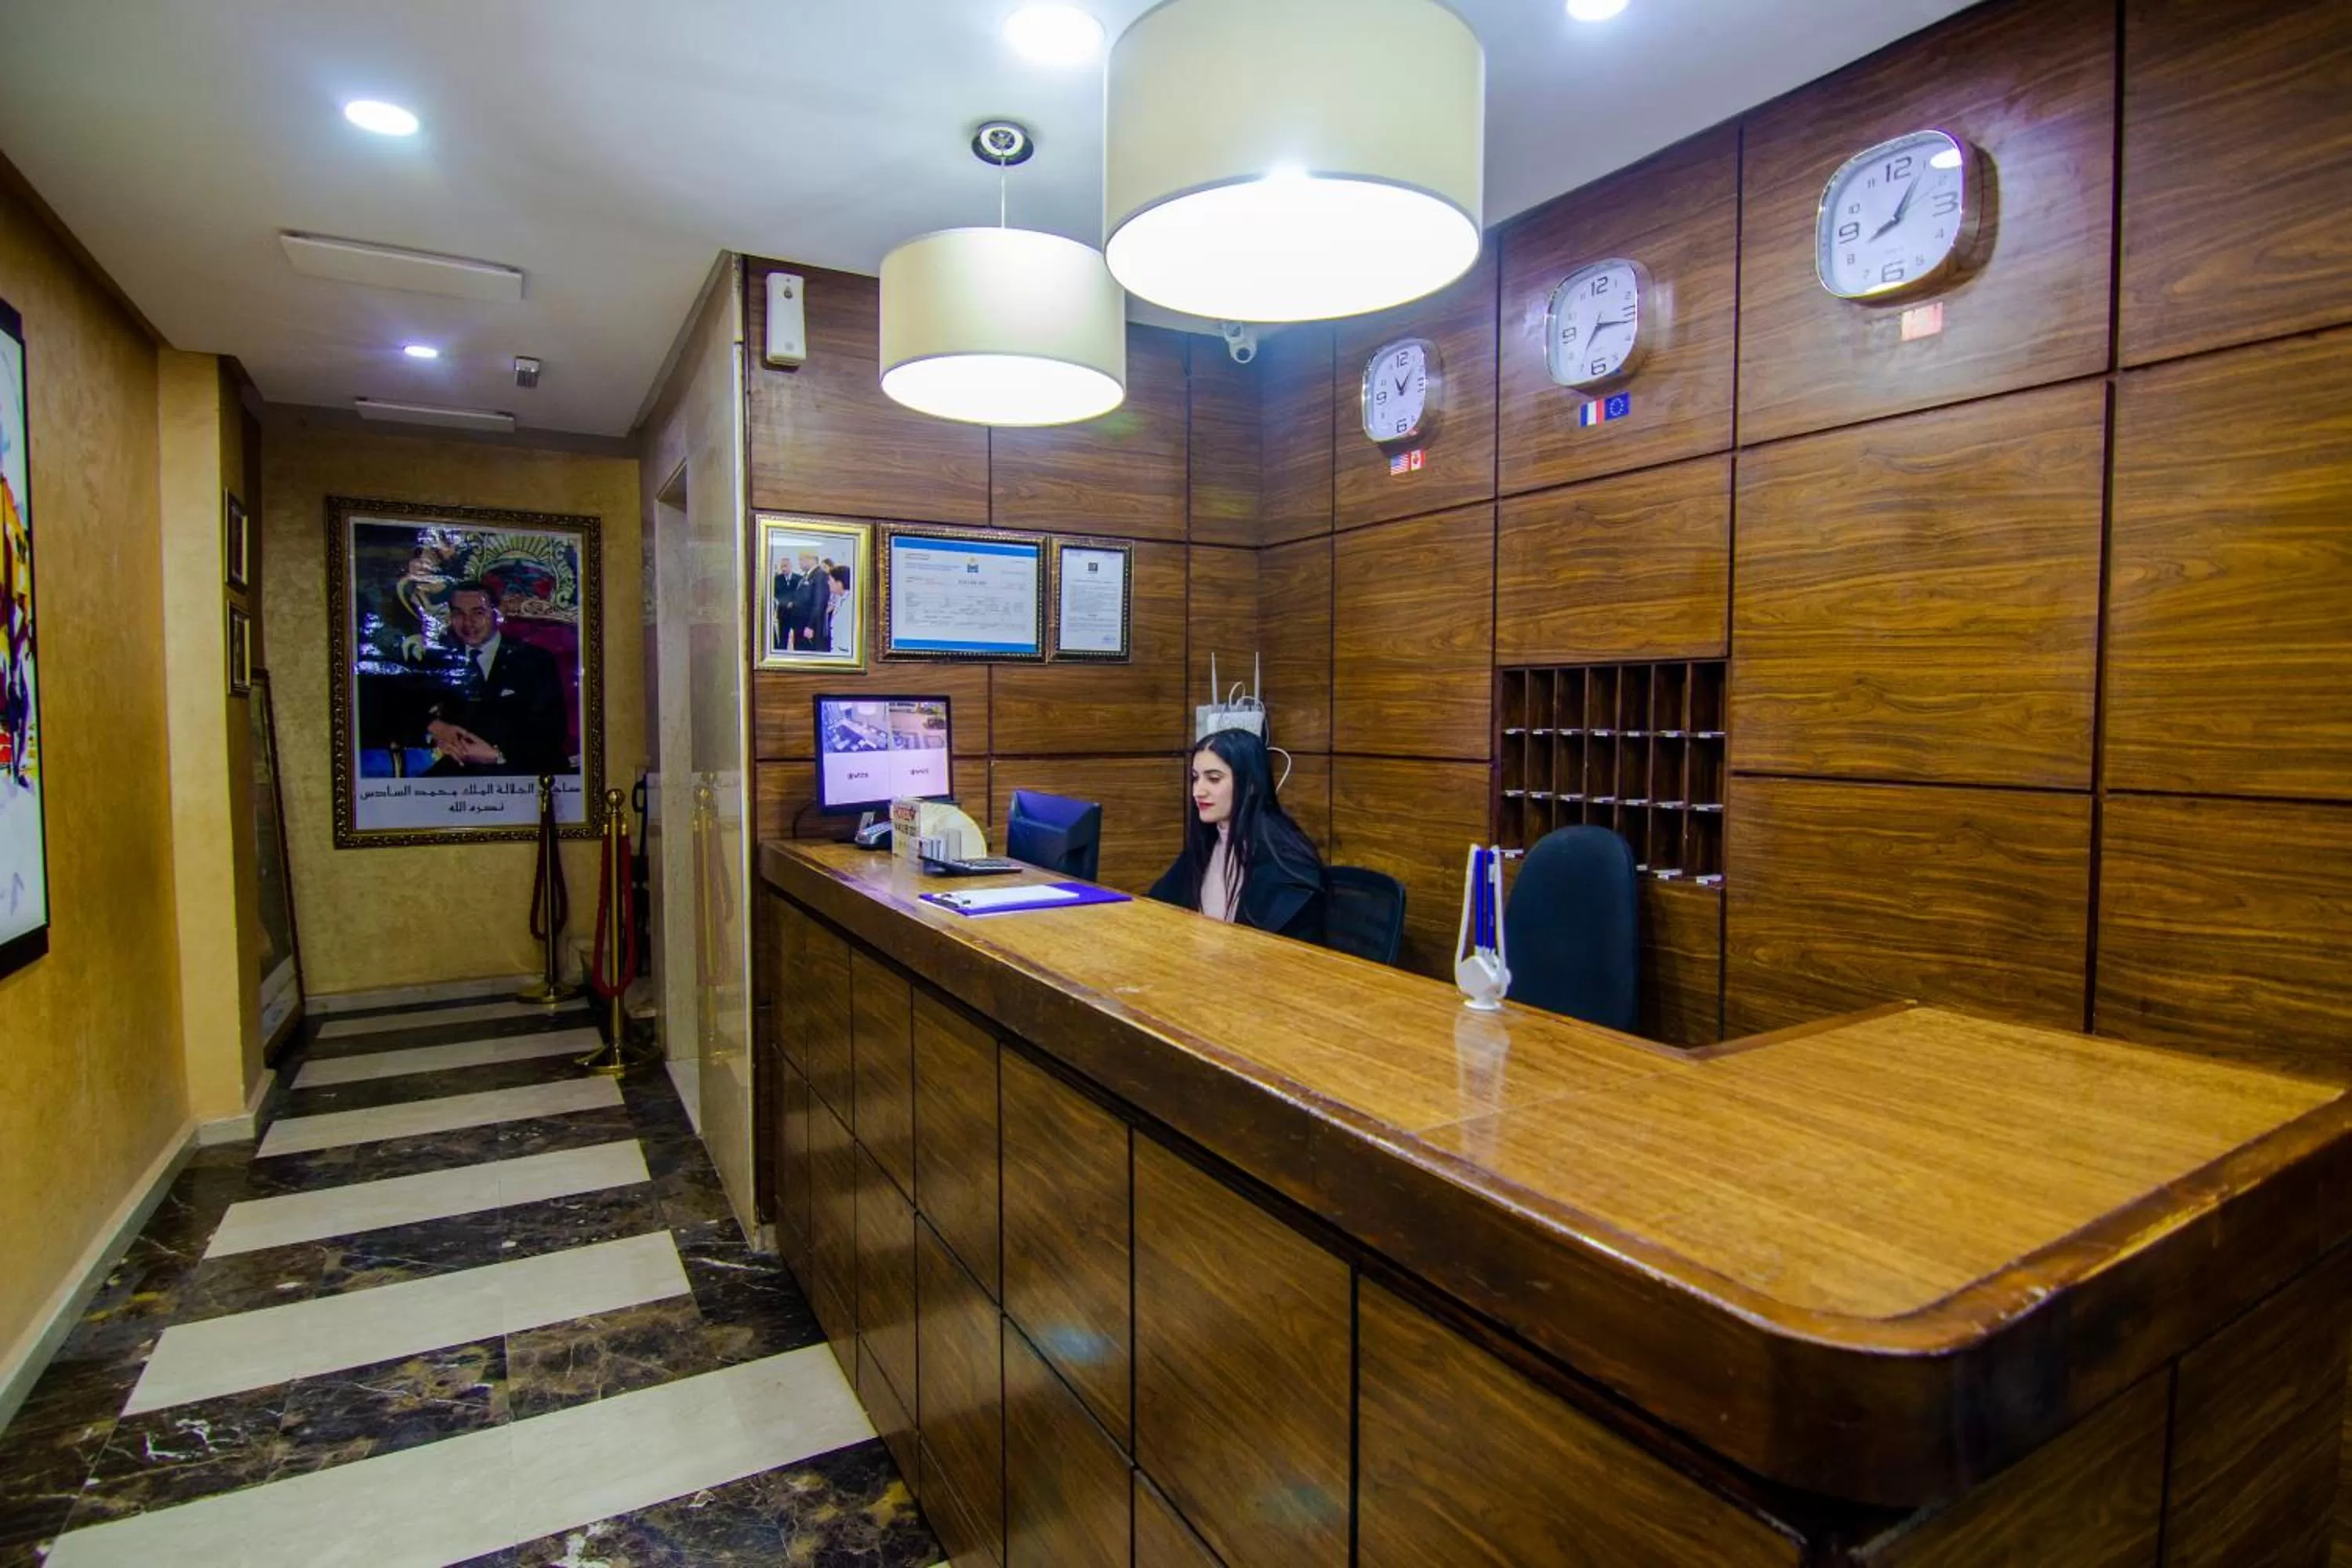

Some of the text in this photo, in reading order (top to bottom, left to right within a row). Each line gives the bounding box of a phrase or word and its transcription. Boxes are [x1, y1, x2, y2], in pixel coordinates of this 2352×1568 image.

[1885, 156, 1912, 183] 12
[1932, 191, 1958, 217] 3
[1838, 221, 1860, 245] 9
[1882, 260, 1905, 282] 6
[1591, 276, 1608, 296] 12
[1621, 304, 1636, 322] 3
[1563, 326, 1577, 344] 9
[1396, 351, 1408, 368] 12
[1591, 358, 1606, 375] 6
[1417, 377, 1425, 392] 3
[1376, 391, 1387, 405] 9
[1396, 419, 1407, 433] 6
[360, 784, 411, 800] السادس
[414, 789, 457, 797] محمد
[461, 782, 492, 796] الملك
[538, 782, 581, 797] صاح
[448, 800, 466, 812] الله
